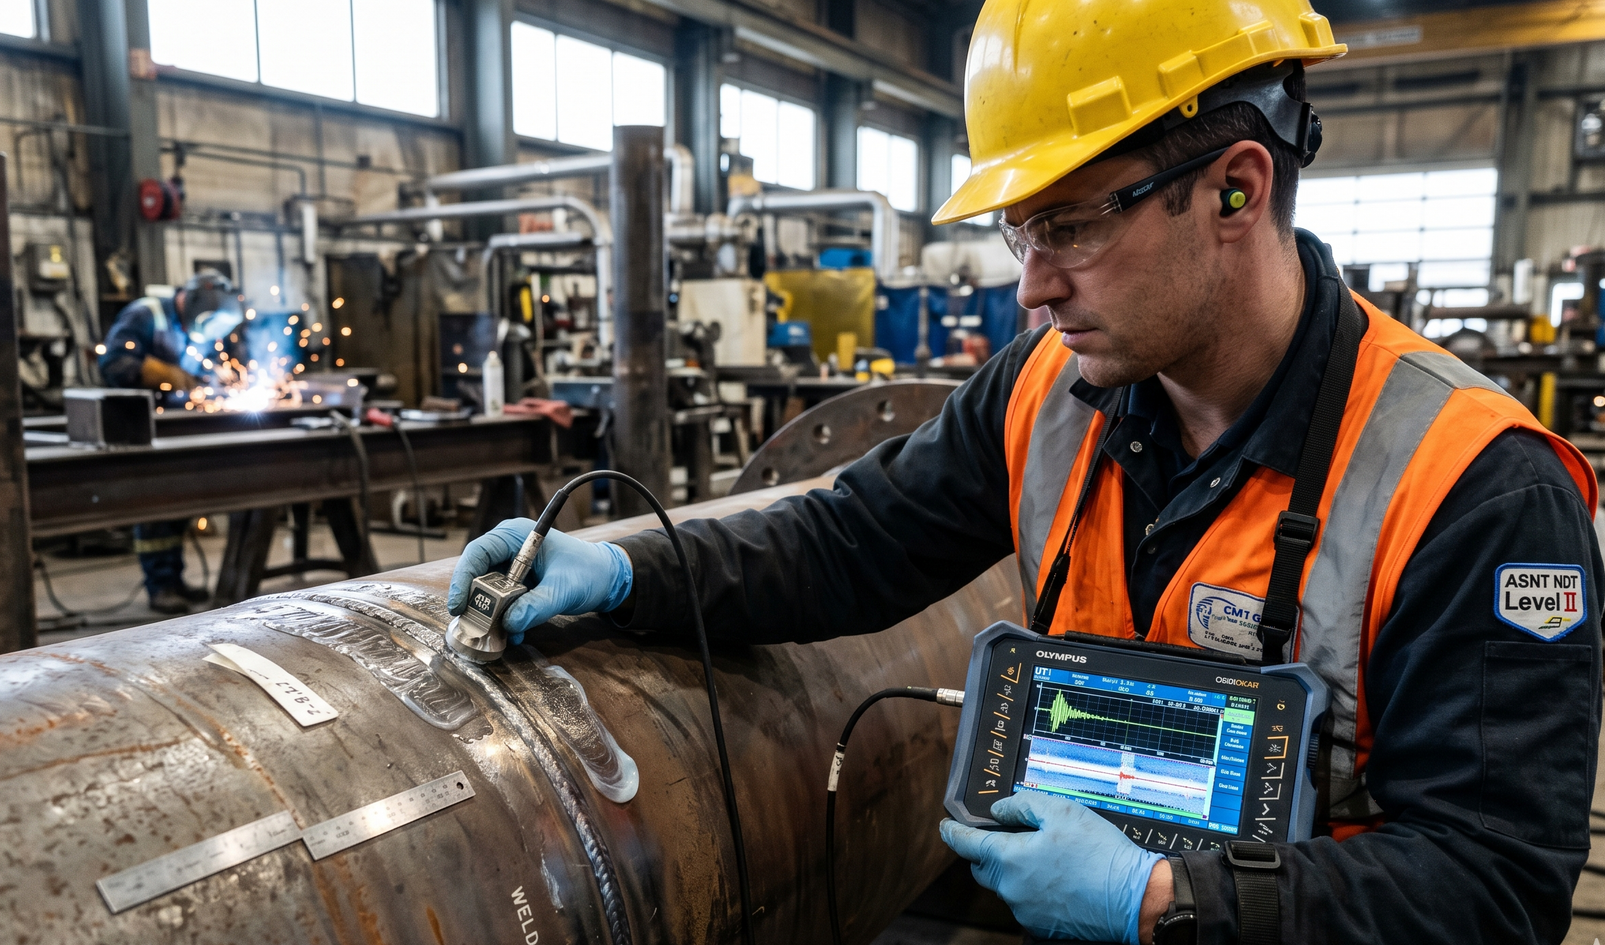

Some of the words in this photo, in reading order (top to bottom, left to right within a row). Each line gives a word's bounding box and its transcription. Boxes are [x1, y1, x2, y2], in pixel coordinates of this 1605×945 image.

[1505, 574, 1549, 588] ASNT
[1554, 575, 1578, 589] NDT
[1505, 591, 1560, 611] Level
[1564, 592, 1577, 612] II
[1224, 605, 1250, 620] CMT
[1036, 650, 1087, 664] OLYMPUS
[511, 885, 538, 945] WELD
